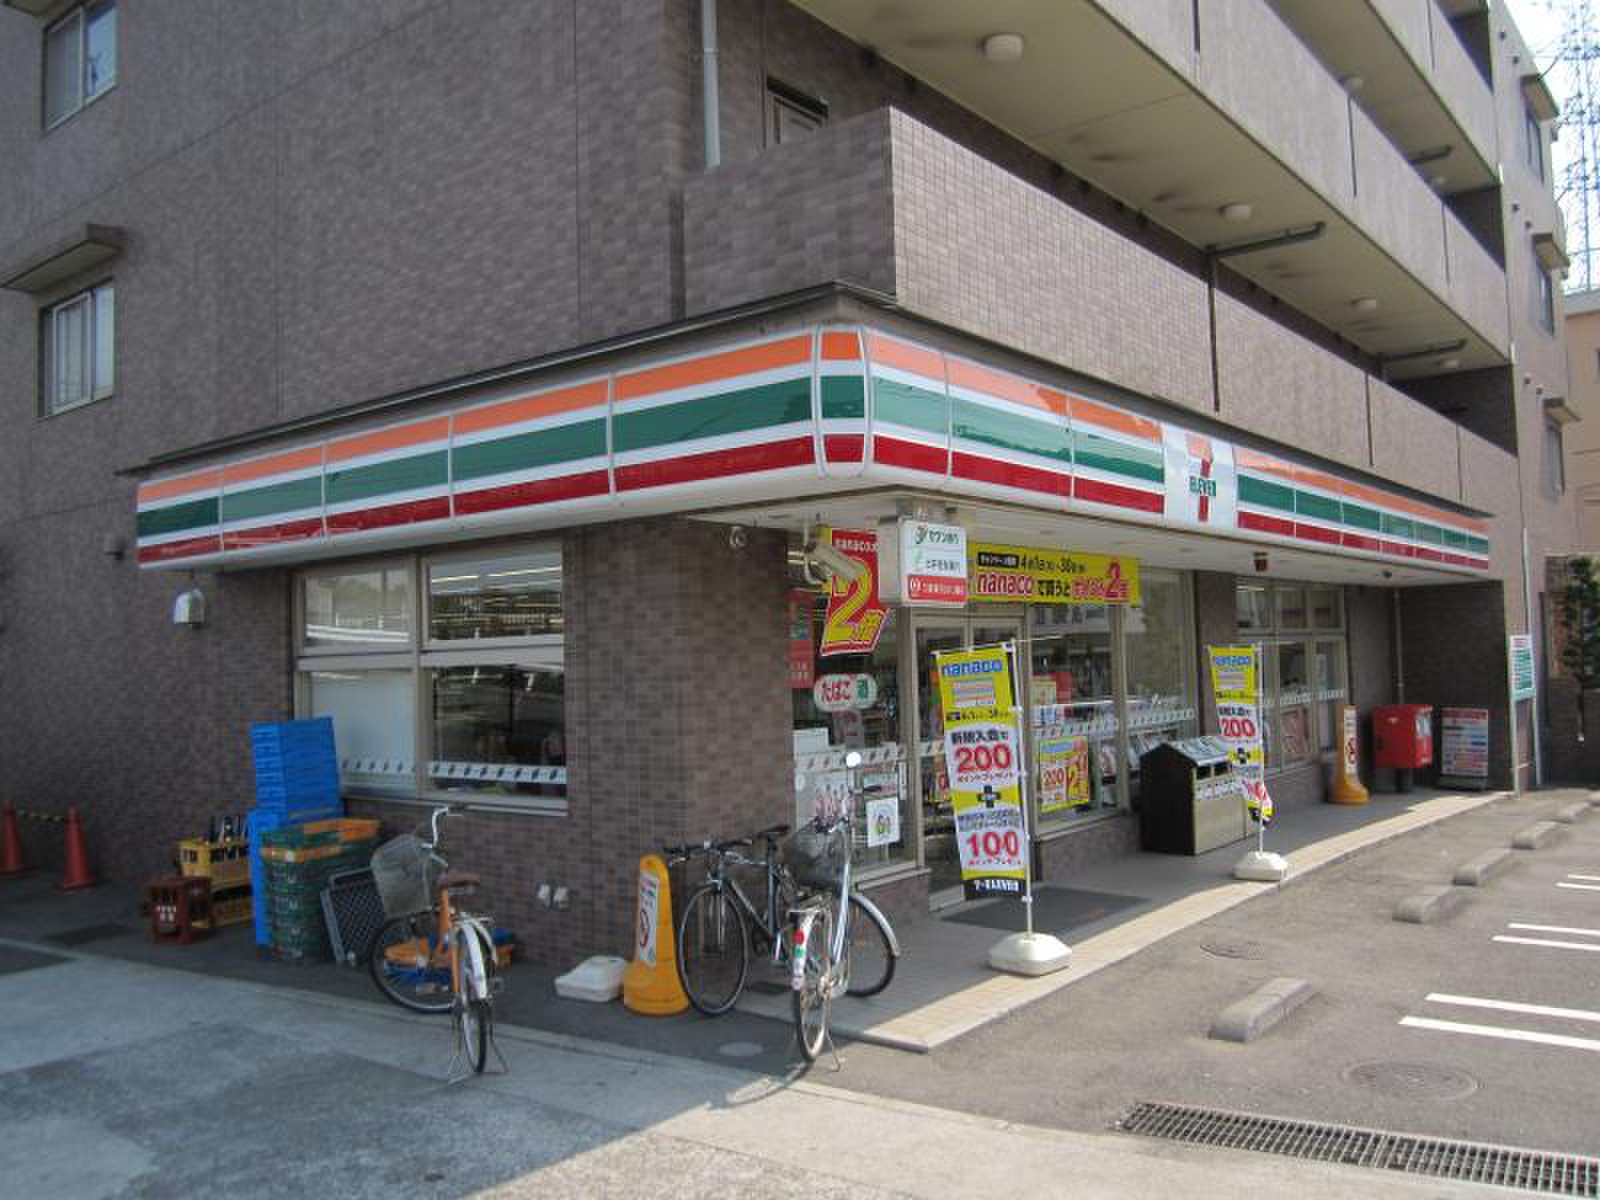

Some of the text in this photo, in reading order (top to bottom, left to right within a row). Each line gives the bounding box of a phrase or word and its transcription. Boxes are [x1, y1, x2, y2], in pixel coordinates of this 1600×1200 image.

[1189, 475, 1217, 497] ELEVEN
[1221, 718, 1256, 738] 200
[955, 744, 1012, 773] 200
[967, 831, 1020, 857] 100
